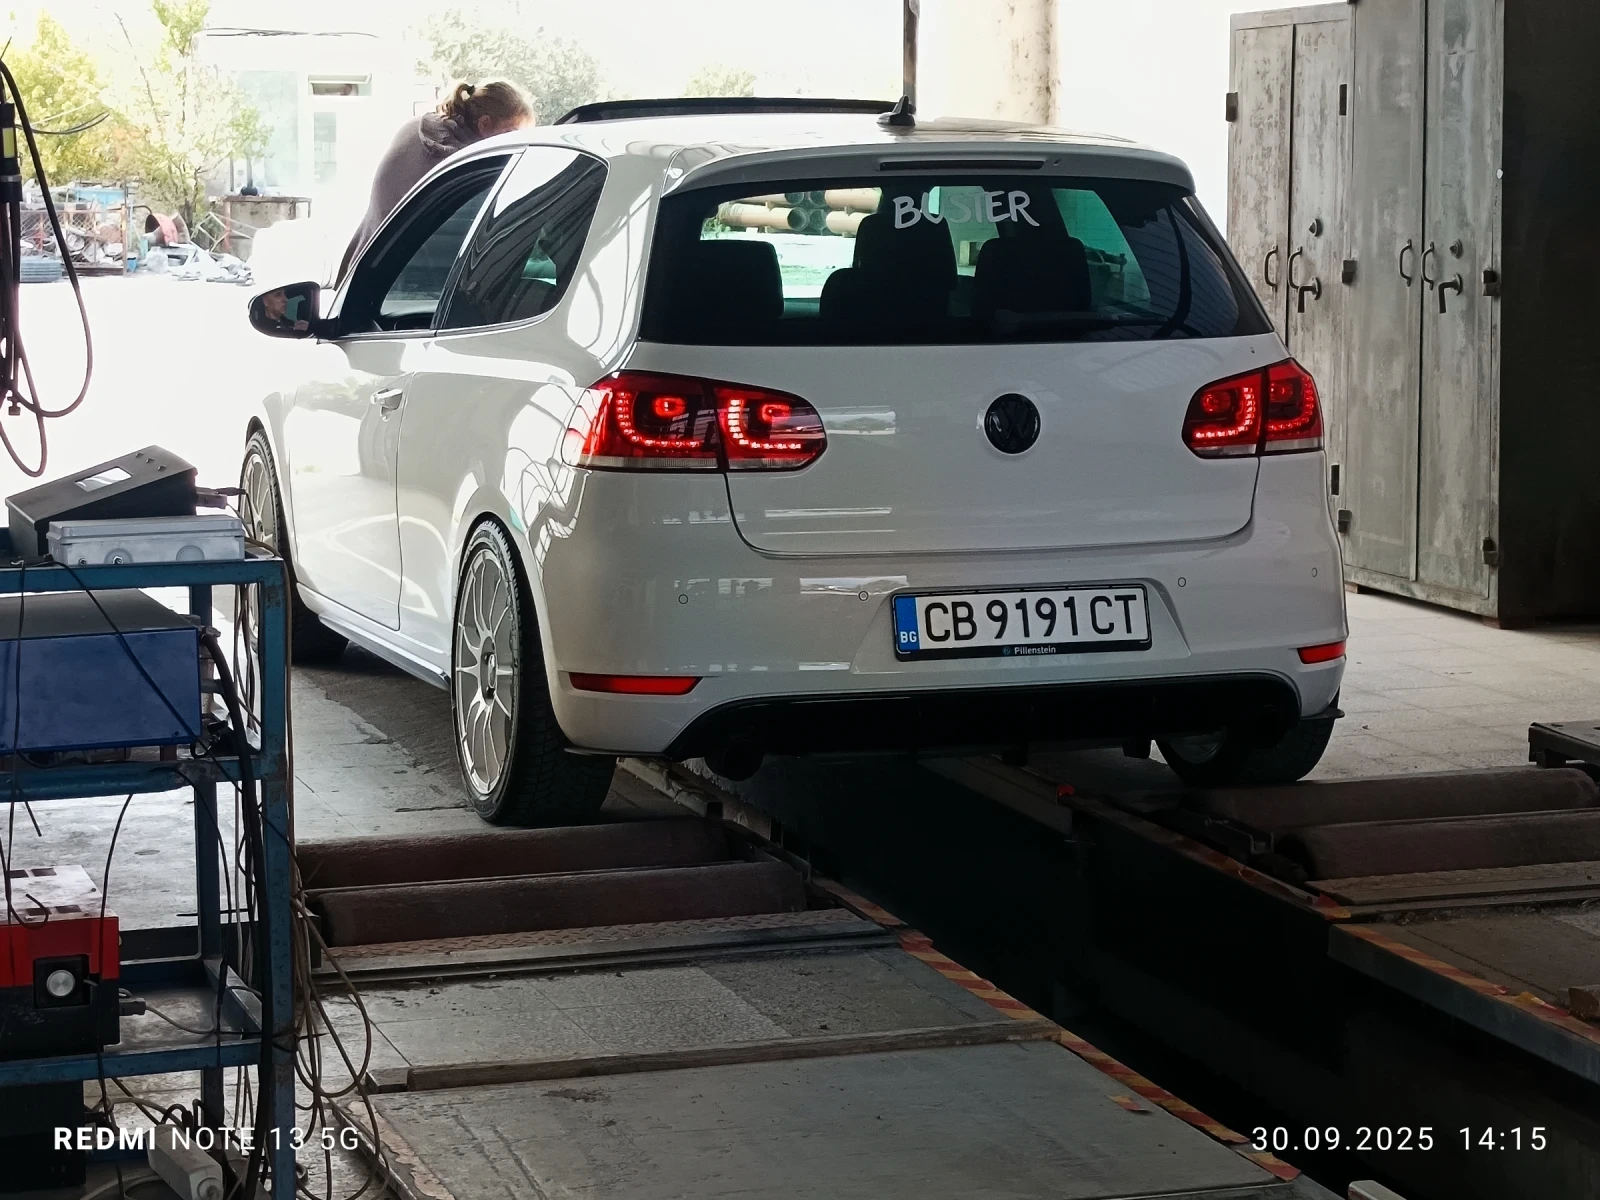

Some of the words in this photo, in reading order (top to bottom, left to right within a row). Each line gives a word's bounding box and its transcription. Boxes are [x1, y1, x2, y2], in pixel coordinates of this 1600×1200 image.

[892, 190, 1041, 230] BUSTER
[924, 601, 978, 642] CB
[985, 596, 1079, 639] 9191
[1089, 594, 1138, 635] CT
[899, 631, 918, 643] BG
[1013, 645, 1057, 655] Pillenstein
